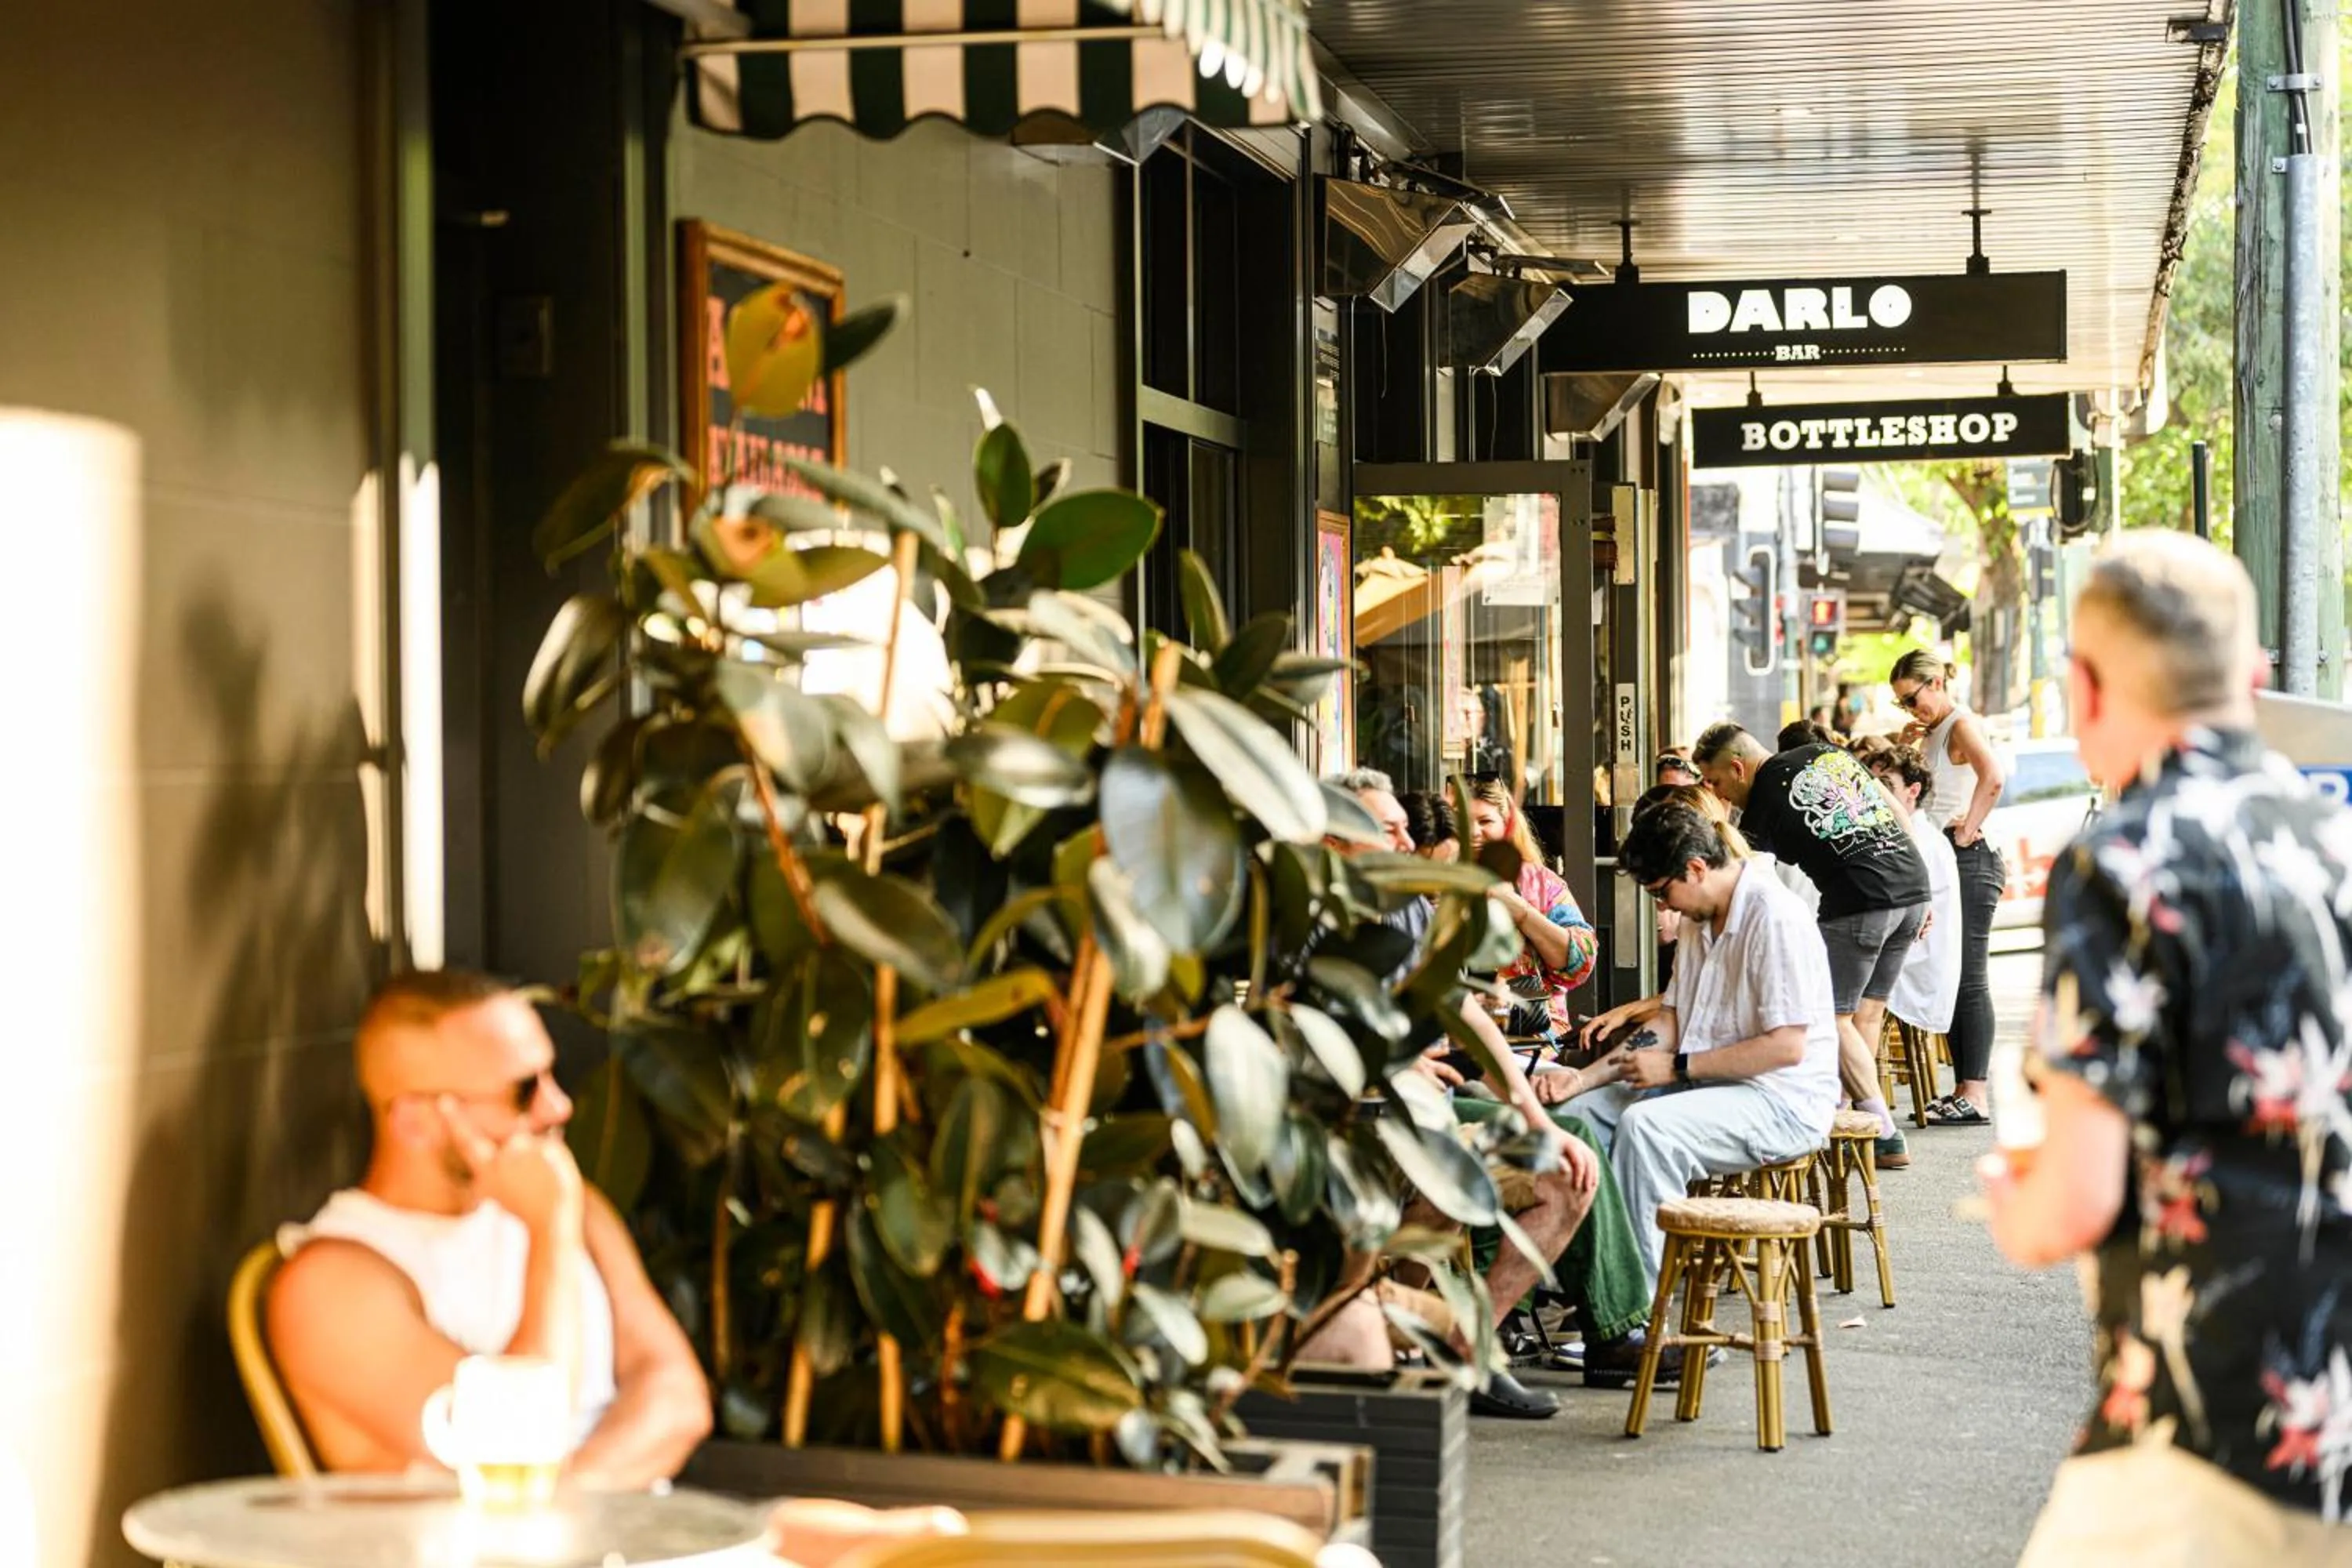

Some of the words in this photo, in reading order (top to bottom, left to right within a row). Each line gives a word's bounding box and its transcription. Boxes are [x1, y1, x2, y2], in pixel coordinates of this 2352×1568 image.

[1687, 284, 1913, 334] DARLO
[1775, 344, 1820, 361] BAR
[1740, 412, 2019, 452] BOTTLESHOP
[1620, 695, 1632, 751] PUSH
